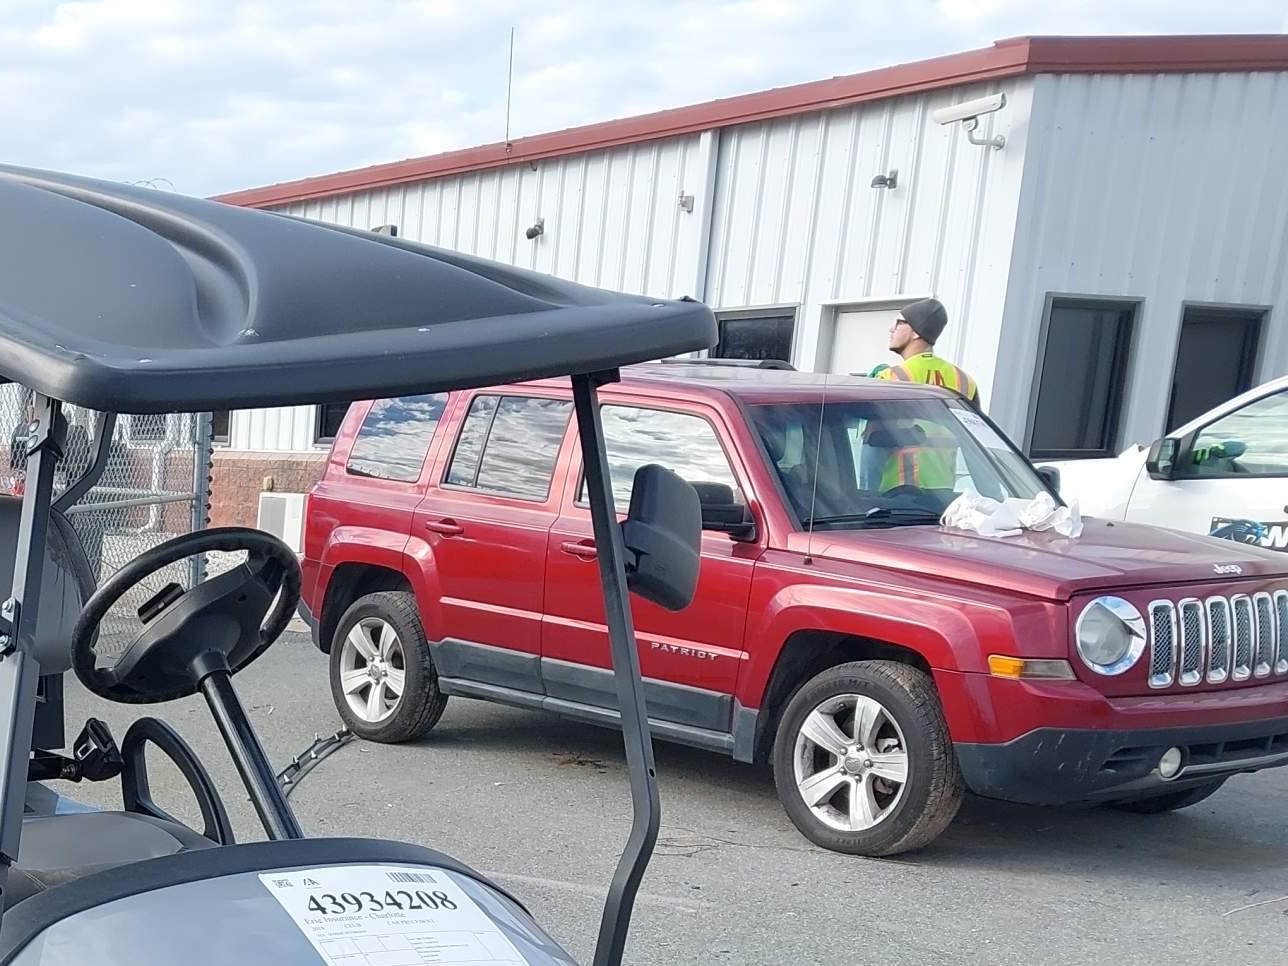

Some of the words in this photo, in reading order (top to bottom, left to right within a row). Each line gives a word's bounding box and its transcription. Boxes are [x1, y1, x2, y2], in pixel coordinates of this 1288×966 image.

[1213, 564, 1242, 575] Jeep
[651, 642, 719, 660] PATRIOT
[308, 890, 458, 914] 43934208
[322, 914, 363, 922] Insurance
